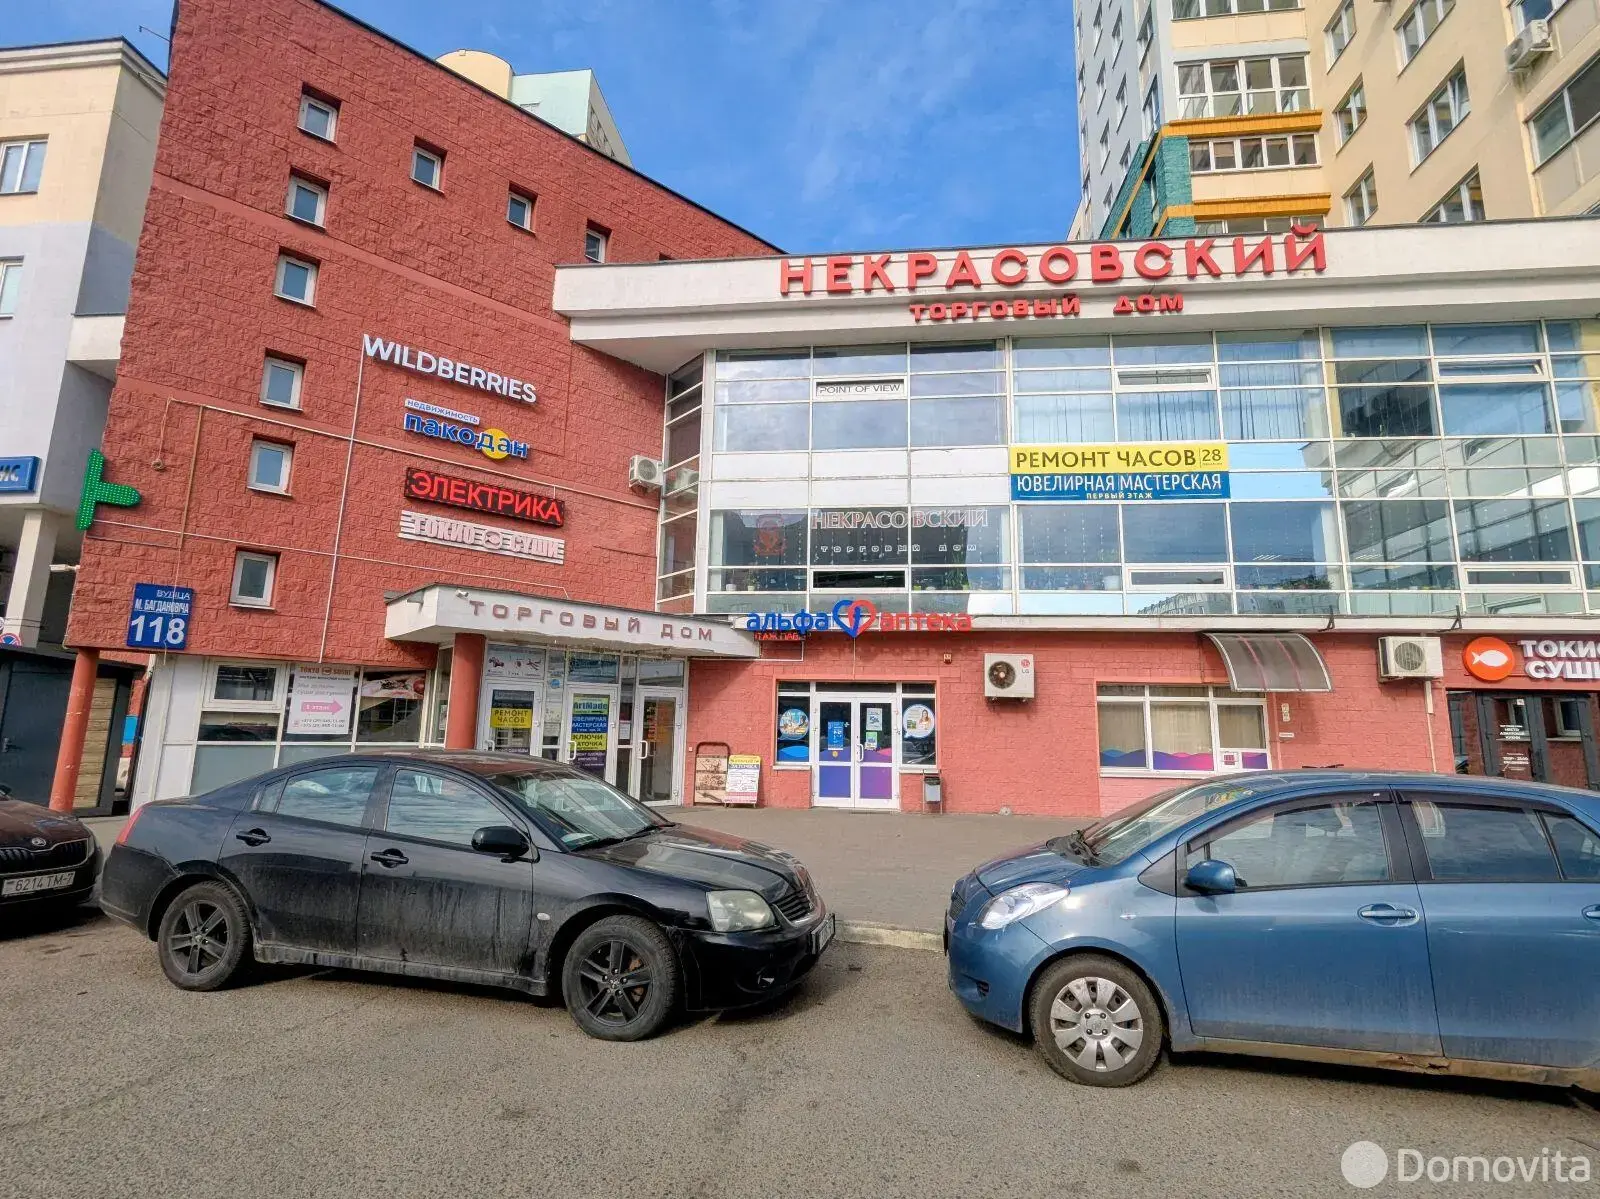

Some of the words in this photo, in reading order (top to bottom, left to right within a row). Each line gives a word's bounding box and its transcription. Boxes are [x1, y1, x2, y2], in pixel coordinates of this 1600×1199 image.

[780, 223, 1326, 296] НЕКРАСОВСКИЙ
[909, 293, 1080, 322] ТОРГОВЫЙ
[1113, 293, 1184, 314] ДОМ
[363, 333, 537, 403] WILDBERRIES
[819, 386, 851, 394] POINT
[854, 385, 870, 393] OF
[872, 383, 901, 393] VIEW
[406, 399, 478, 424] недвижимость
[404, 412, 529, 460] пакодан
[1016, 450, 1110, 468] РЕМОНТ
[1117, 449, 1196, 467] ЧАСОВ
[1202, 449, 1222, 462] 28
[1017, 475, 1115, 492] ЮВЕЛИРНАЯ
[1119, 474, 1222, 491] МАСТЕРСКАЯ
[1086, 491, 1125, 499] ПЕРВЫЙ
[411, 472, 563, 524] ЭЛЕКТРИКА
[811, 509, 988, 530] НЕКРАСОВСКИЙ
[413, 515, 476, 544] ТОКИО
[509, 535, 560, 557] СУШИ
[820, 544, 921, 553] ТОРГОВЫЙ
[938, 544, 977, 552] ДОМ
[131, 615, 185, 644] 118
[469, 600, 641, 634] ТОРГОВЫЙ
[660, 623, 713, 642] ДОМ
[746, 608, 830, 635] альфа
[879, 612, 972, 632] аптека
[1520, 639, 1600, 658] ТОКИ
[494, 708, 529, 717] РЕМОНТ
[497, 715, 526, 724] ЧАСОВ
